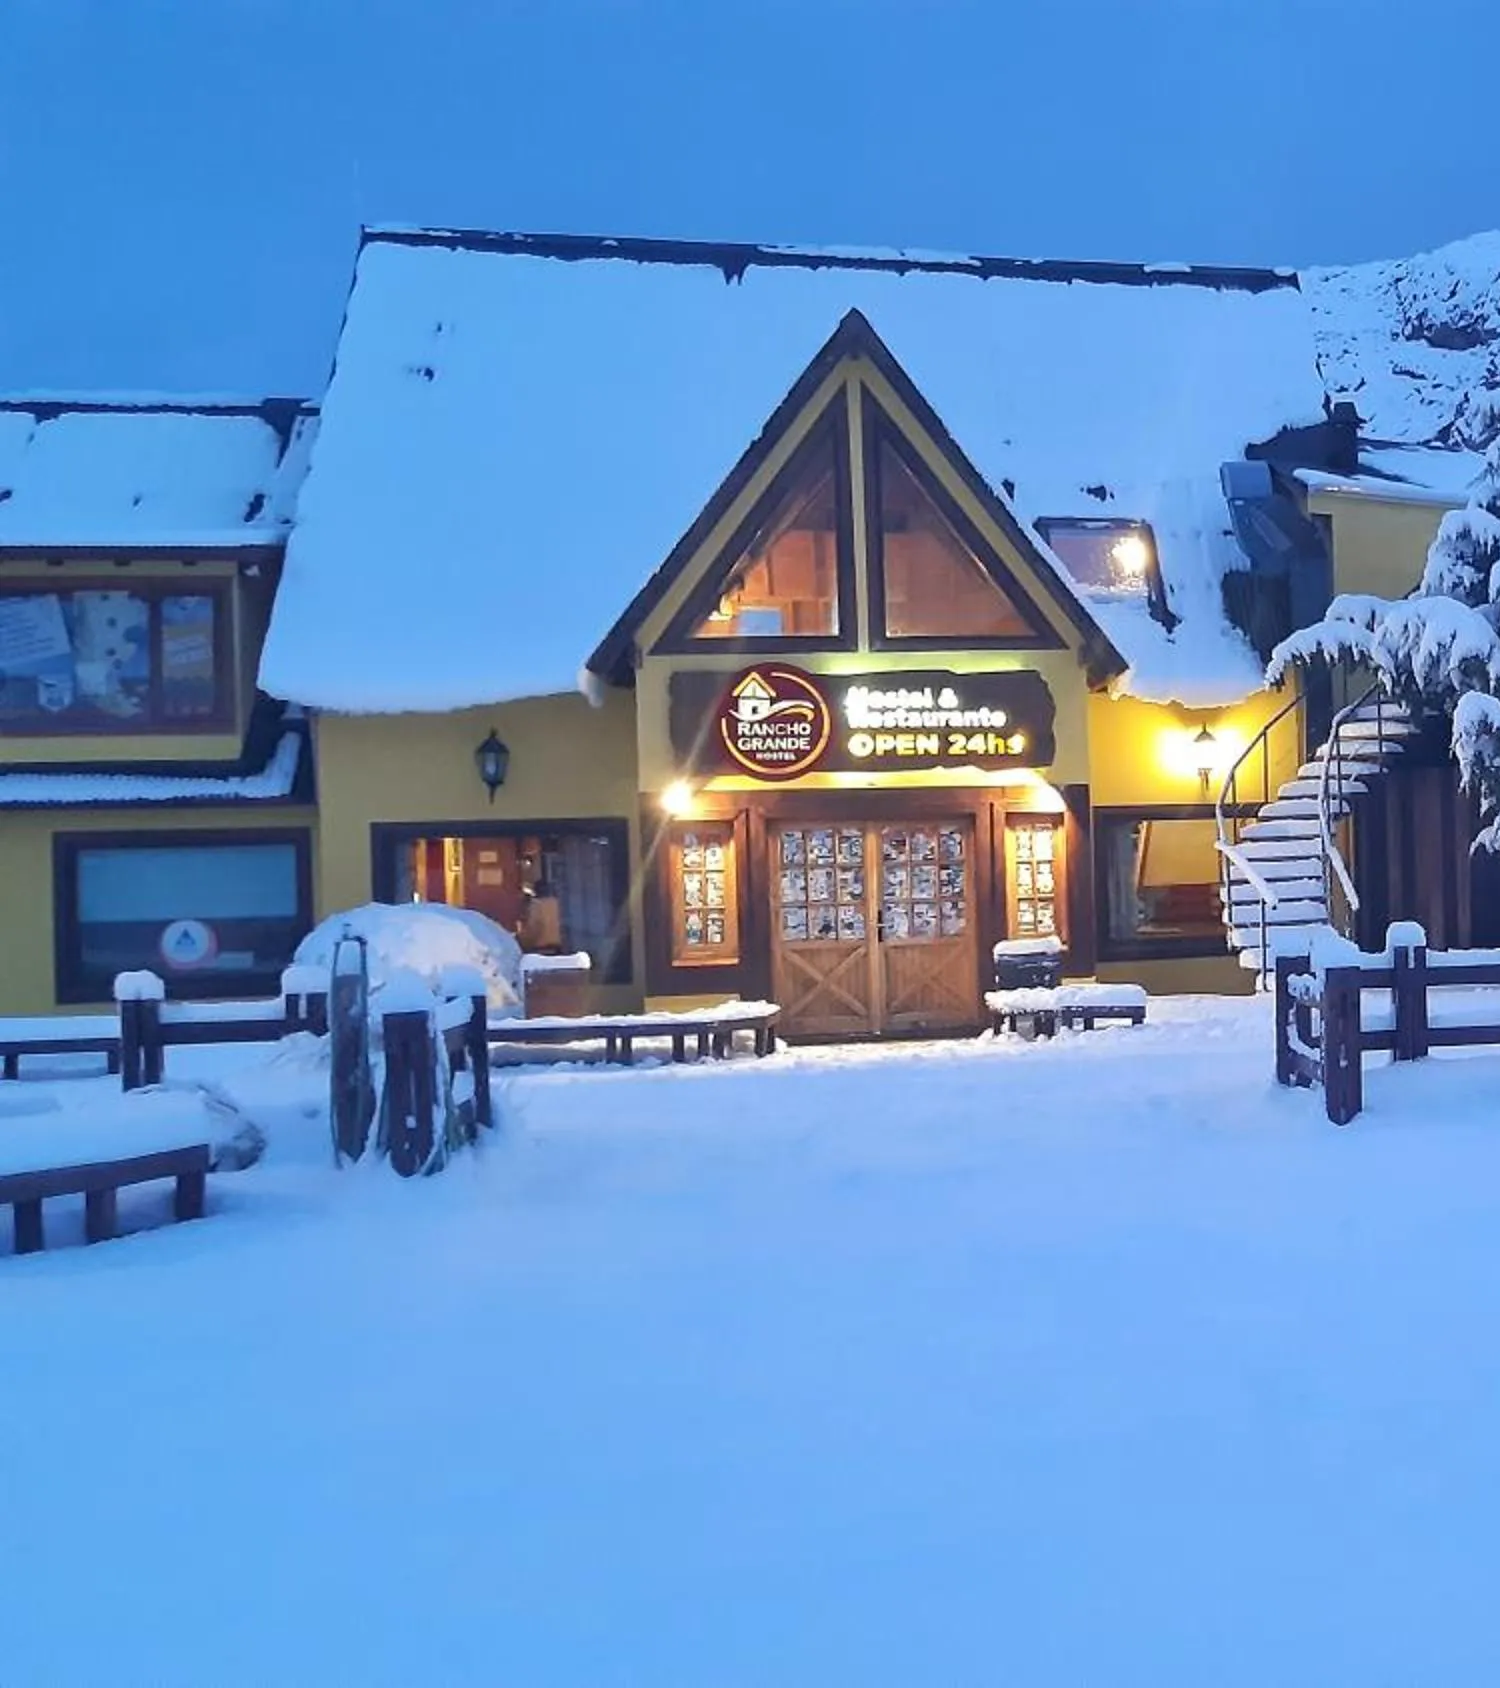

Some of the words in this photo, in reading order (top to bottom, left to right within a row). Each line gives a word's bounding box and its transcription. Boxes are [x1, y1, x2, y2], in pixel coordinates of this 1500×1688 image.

[737, 721, 812, 736] RANCHO
[737, 737, 812, 751] GRANDE
[847, 731, 939, 758] OPEN
[948, 731, 1025, 757] 24hs
[755, 751, 797, 762] HOSTEL
